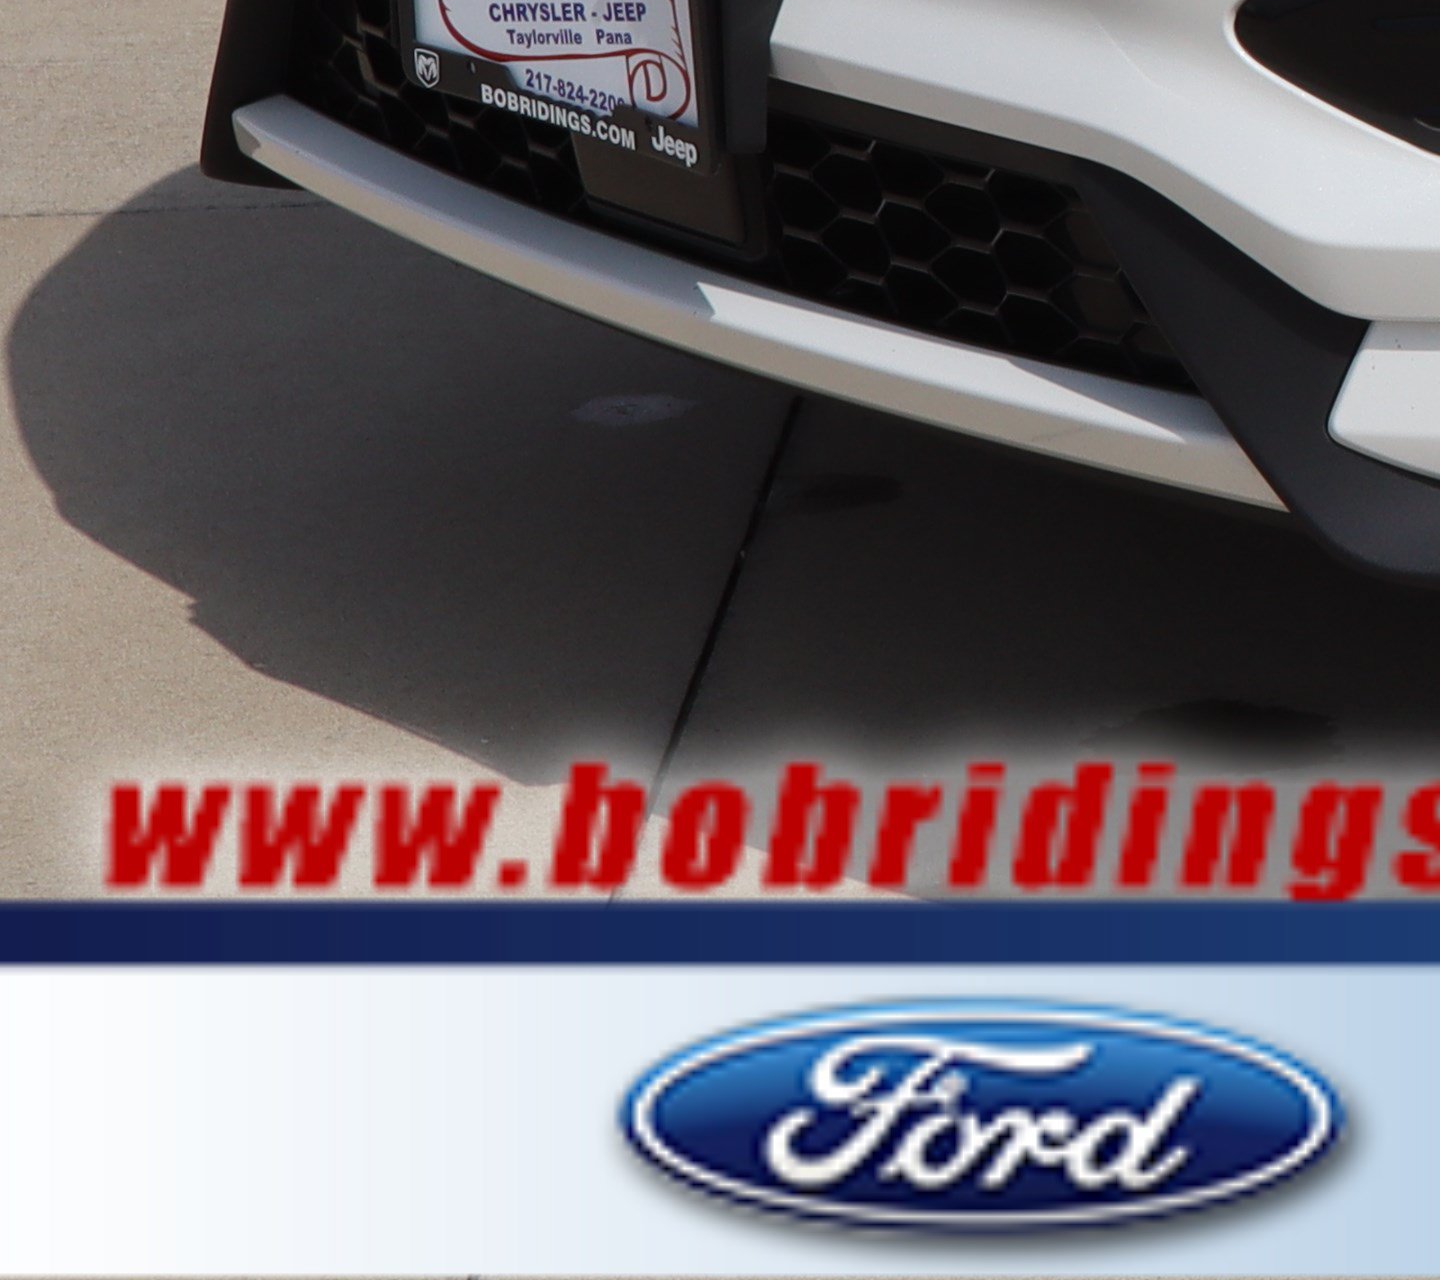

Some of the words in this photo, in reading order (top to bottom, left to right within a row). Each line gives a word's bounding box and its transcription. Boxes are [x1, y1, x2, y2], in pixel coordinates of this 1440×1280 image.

[488, 2, 587, 23] CHRYSLER
[602, 2, 647, 22] JEEP
[505, 28, 583, 49] Taylorville
[595, 28, 633, 45] Pana
[480, 82, 637, 151] BOBRIDINGS.COM
[650, 124, 699, 169] Jeep
